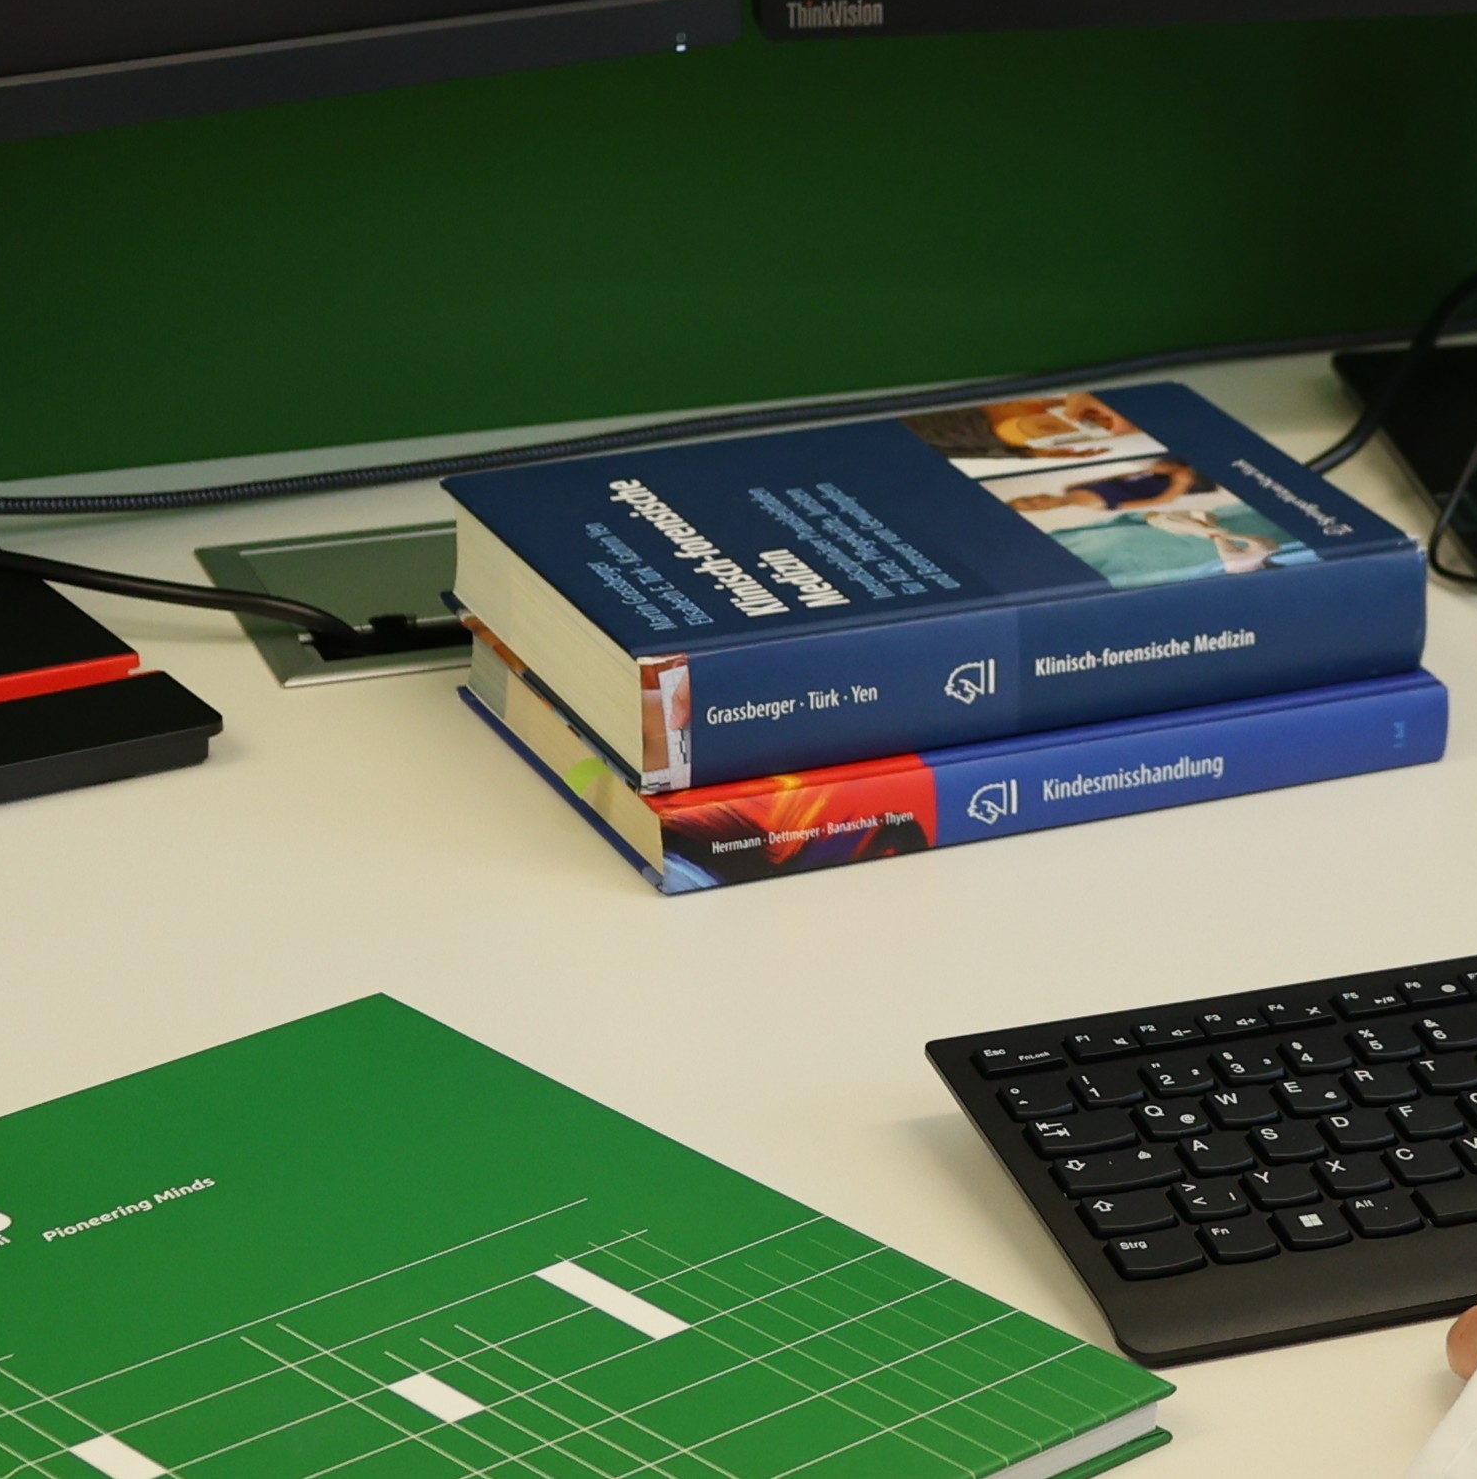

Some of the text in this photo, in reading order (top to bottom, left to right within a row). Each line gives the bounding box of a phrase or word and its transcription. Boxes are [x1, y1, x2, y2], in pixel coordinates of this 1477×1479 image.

[786, 0, 883, 28] ThinkVision
[609, 478, 791, 618] Klinisch-forensische
[759, 548, 851, 610] Medizin
[1035, 628, 1256, 677] Klinisch-forensische Medizin
[706, 684, 878, 725] Grassberger Türk Yen
[1042, 754, 1224, 803] Kindesmisshandlung
[711, 810, 914, 855] Herrmann Dettmeyer Banaschak Thyen
[983, 1003, 1285, 1057] Esc F1 F4
[1144, 1081, 1303, 1117] Q E
[1193, 1139, 1209, 1152] A
[41, 1177, 216, 1243] Pioneering Minds
[1119, 1199, 1375, 1250] Strg Fn Alt
